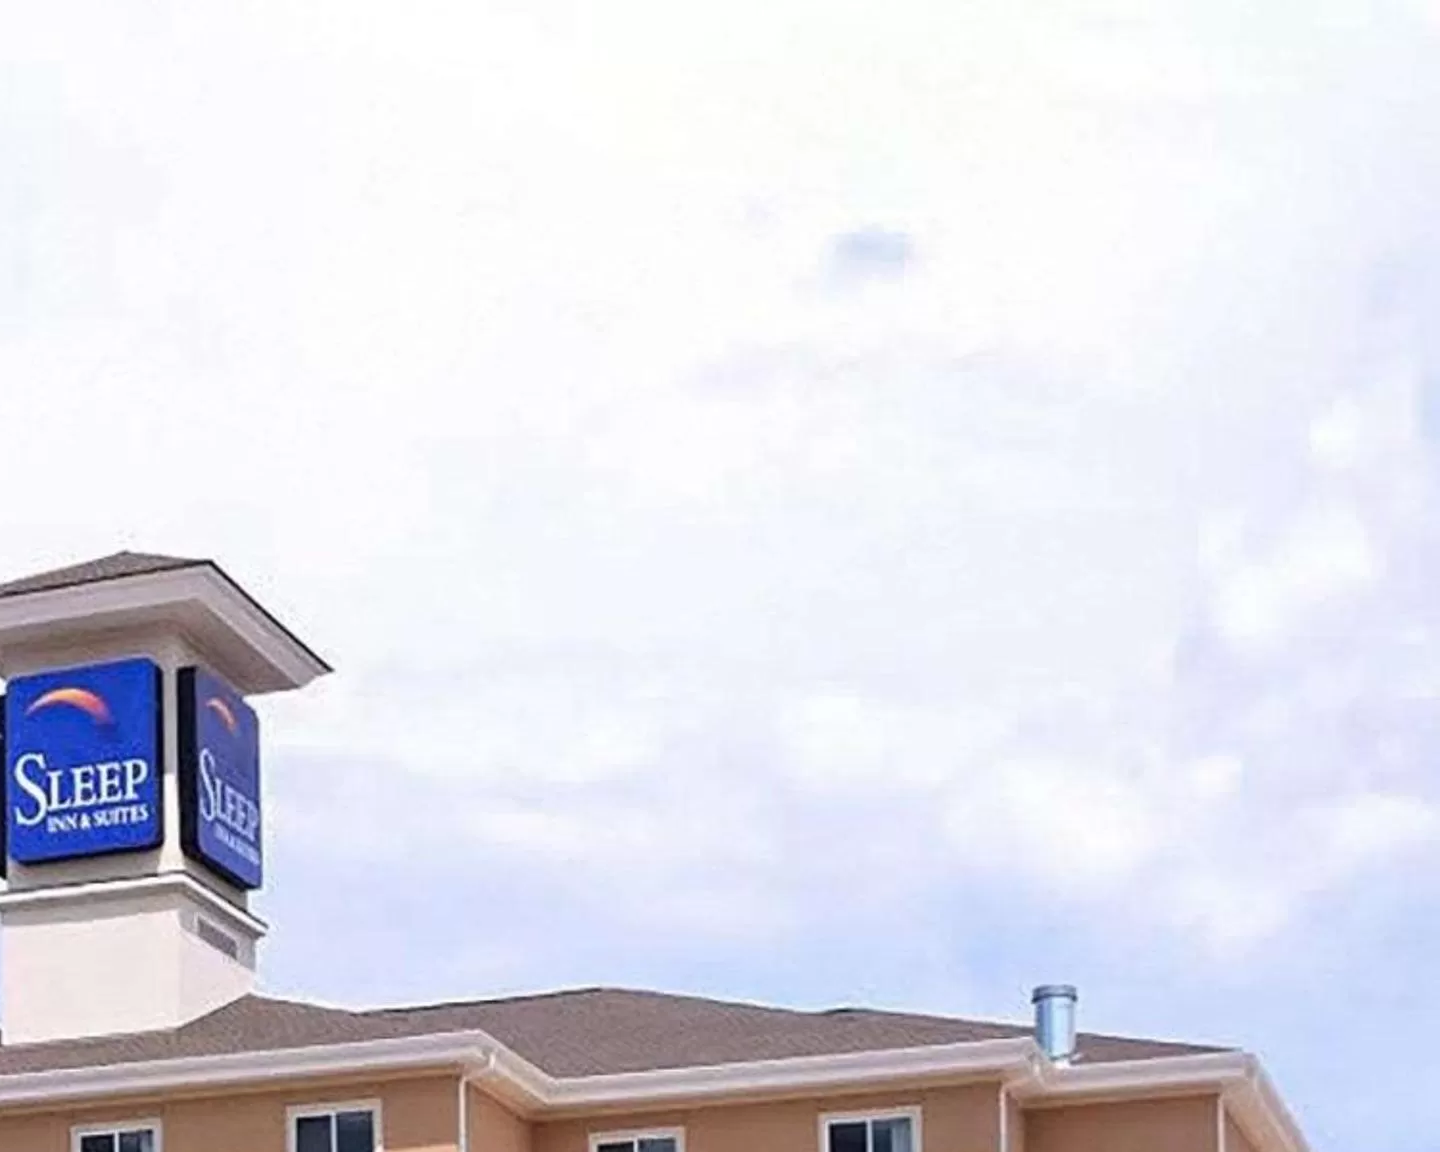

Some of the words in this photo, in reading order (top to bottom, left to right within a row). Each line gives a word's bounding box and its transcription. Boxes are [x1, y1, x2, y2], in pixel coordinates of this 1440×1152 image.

[14, 752, 148, 826] SLEEP
[46, 812, 78, 833] INN
[92, 803, 149, 827] SUITES
[200, 748, 258, 842] SLEEP
